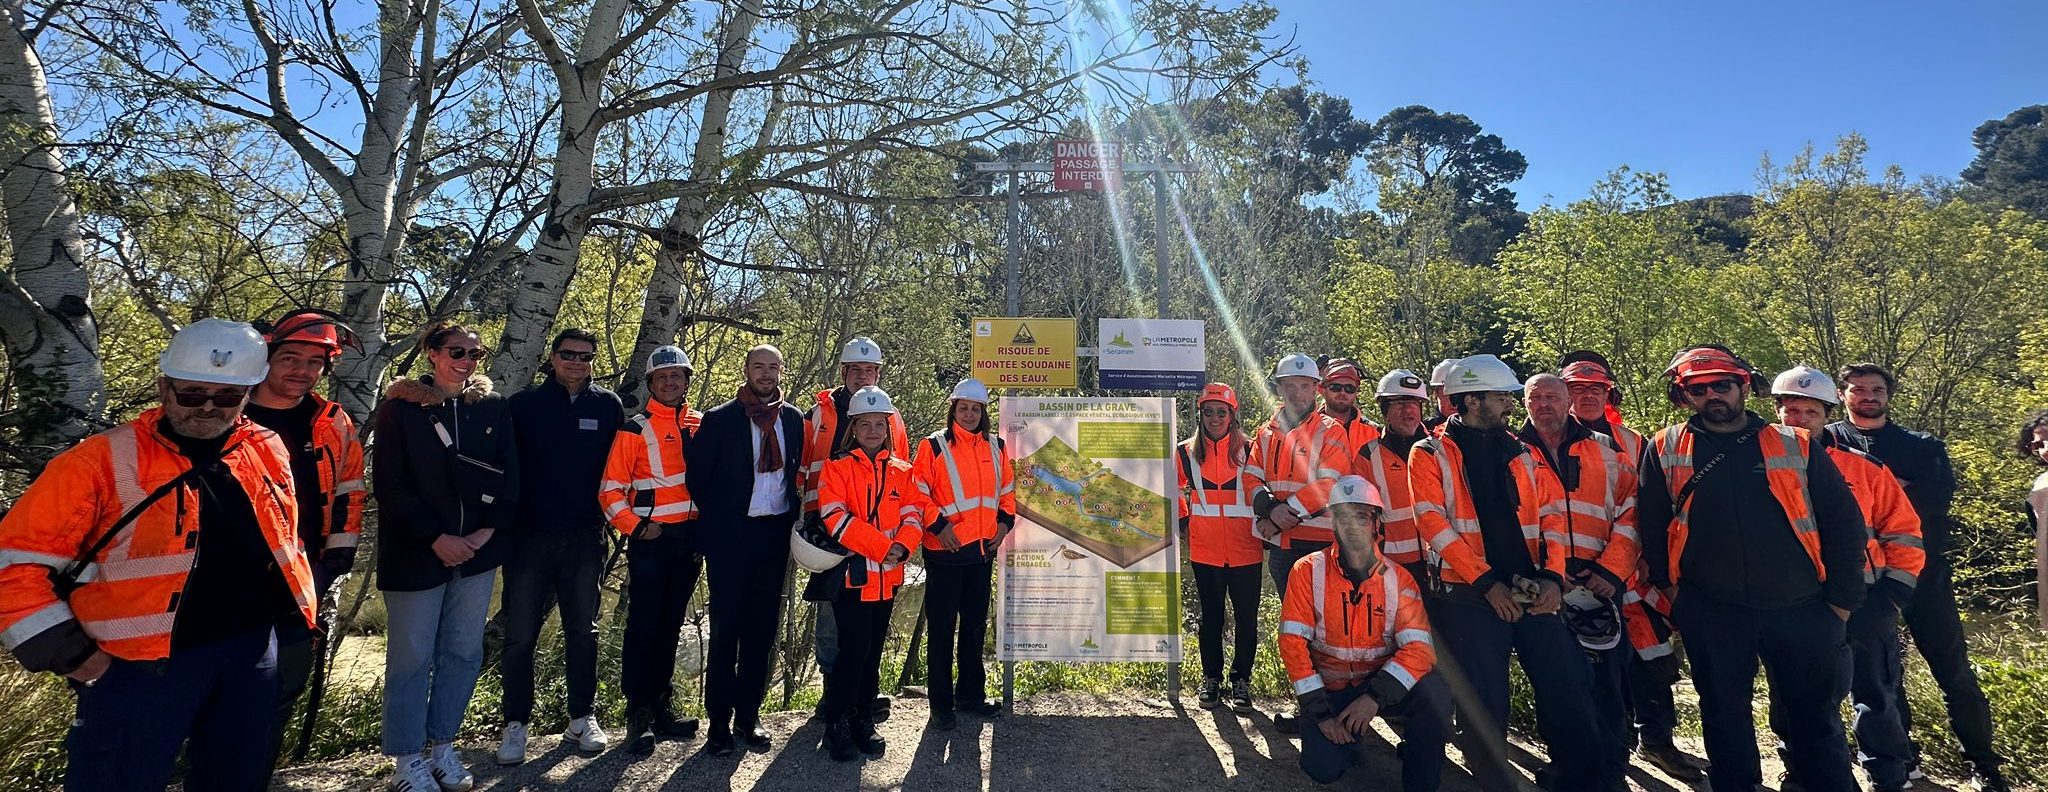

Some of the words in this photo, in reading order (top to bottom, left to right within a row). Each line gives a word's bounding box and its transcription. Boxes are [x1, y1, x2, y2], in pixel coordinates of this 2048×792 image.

[1057, 143, 1119, 157] DANGER
[1061, 160, 1117, 169] PASSAGE
[1061, 171, 1116, 180] INTERDIT
[998, 347, 1034, 355] RISQUE
[1037, 347, 1050, 355] DE
[1021, 361, 1071, 369] SOUDAINE
[999, 374, 1019, 382] DES
[1021, 374, 1048, 382] EAUX
[1039, 402, 1073, 411] BASSIN
[1076, 402, 1089, 411] DE
[1091, 402, 1105, 411] LA
[1105, 402, 1136, 411] GRAVE
[1006, 554, 1015, 567] 5
